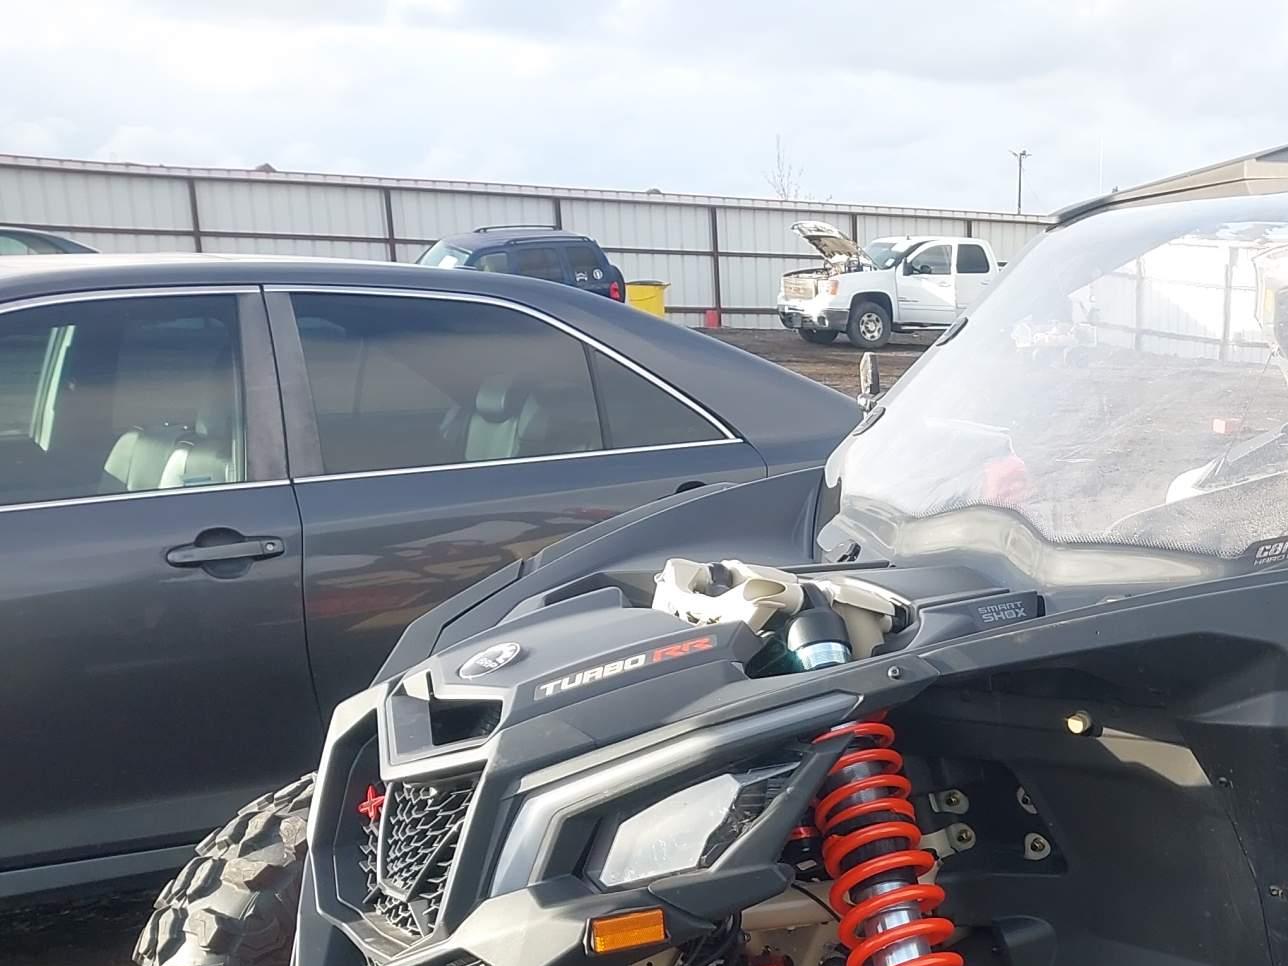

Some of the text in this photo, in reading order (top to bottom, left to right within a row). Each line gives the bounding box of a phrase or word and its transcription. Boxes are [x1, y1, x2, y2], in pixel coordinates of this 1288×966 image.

[982, 608, 1027, 623] SHOX
[539, 636, 714, 697] TURBO RR
